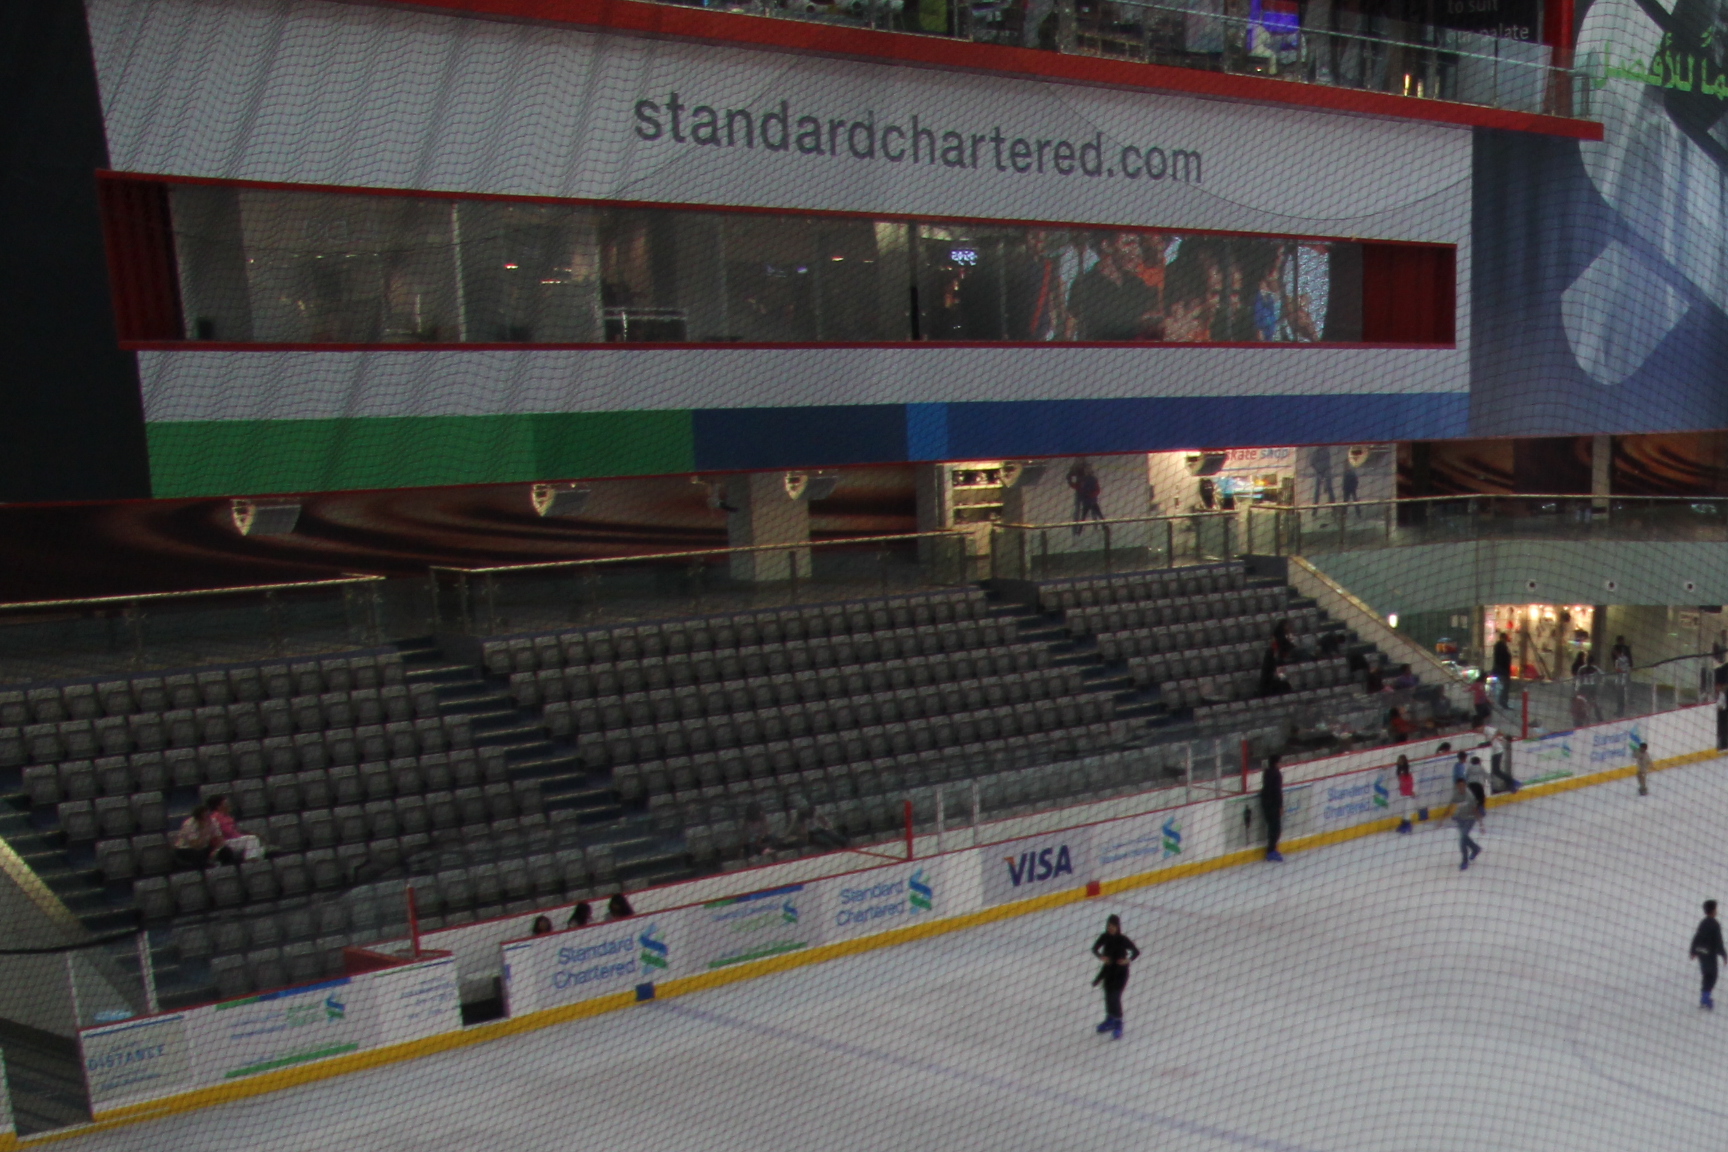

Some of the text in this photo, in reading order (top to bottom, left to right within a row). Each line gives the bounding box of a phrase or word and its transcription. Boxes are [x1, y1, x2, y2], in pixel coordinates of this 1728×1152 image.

[634, 93, 1202, 185] standardchartered.com
[1003, 845, 1073, 887] VISA
[840, 879, 905, 905] Standard
[835, 901, 905, 926] Chartered
[557, 936, 634, 966] Standard
[553, 958, 636, 990] Chartered
